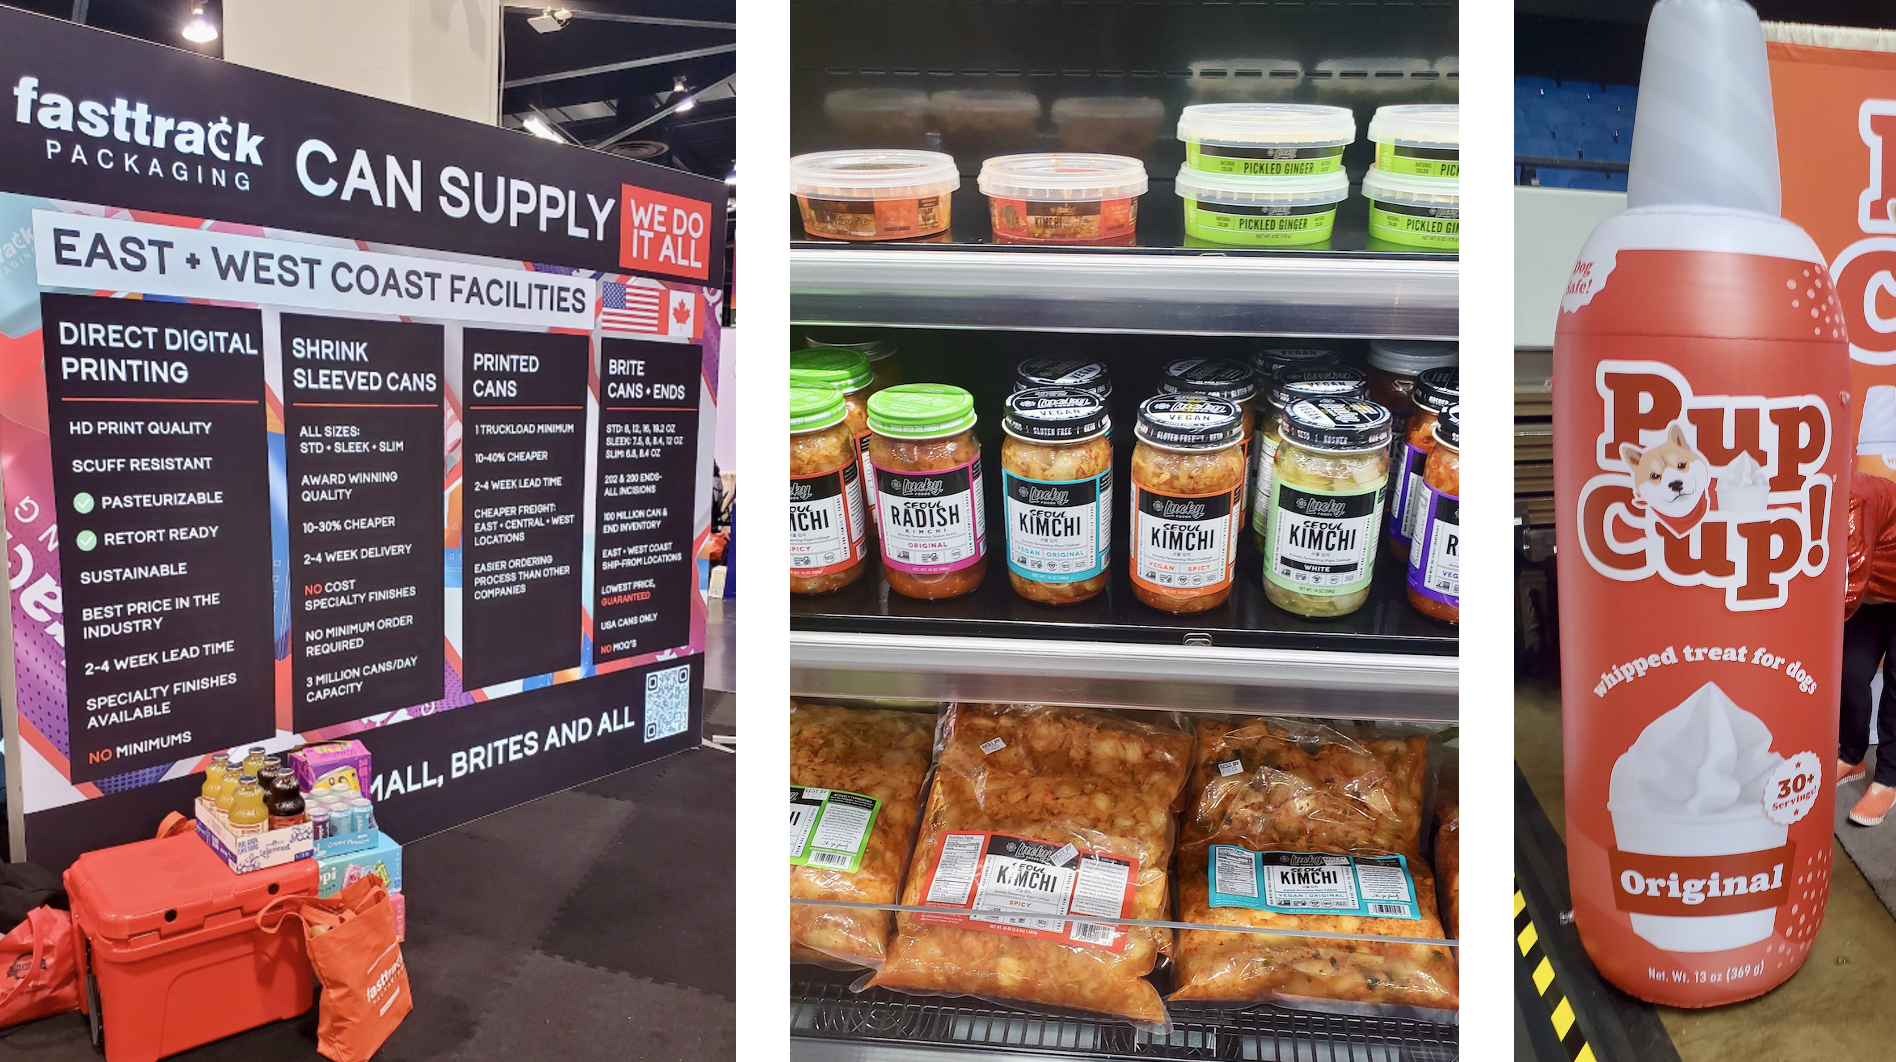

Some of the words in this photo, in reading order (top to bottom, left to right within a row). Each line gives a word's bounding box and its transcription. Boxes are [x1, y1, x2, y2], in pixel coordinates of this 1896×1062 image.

[13, 77, 265, 166] fasttrack
[46, 139, 250, 191] PACKAGING
[1244, 162, 1281, 175] PICKLED
[1284, 163, 1315, 175] GINGER
[296, 139, 421, 212] CAN
[439, 166, 616, 241] SUPPLY
[630, 199, 668, 231] WE
[672, 205, 704, 239] DO
[1239, 218, 1276, 231] PICKLED
[1279, 218, 1308, 230] GINGER
[1406, 218, 1443, 233] PICKLED
[632, 231, 655, 259] IT
[658, 235, 702, 268] ALL
[53, 227, 174, 274] EAST
[211, 246, 322, 290] WEST
[331, 261, 442, 302] COAST
[450, 275, 586, 314] FACILITIES
[1573, 259, 1595, 277] Dog
[59, 321, 158, 350] DIRECT
[164, 328, 258, 355] DIGITAL
[292, 338, 368, 362] SHRINK
[61, 357, 189, 384] PRINTING
[473, 353, 539, 373] PRINTED
[609, 359, 645, 376] BRITE
[292, 369, 382, 391] SLEEVED
[387, 371, 437, 392] CANS
[473, 379, 517, 397] CANS
[608, 382, 643, 398] CANS
[653, 384, 686, 400] ENDS
[69, 421, 93, 434] HD
[97, 421, 145, 434] PRINT
[148, 422, 212, 435] QUALITY
[300, 426, 322, 437] ALL
[324, 426, 360, 438] SIZES:
[481, 424, 536, 435] TRUCKLOAD
[536, 423, 575, 434] MINIMUM
[1600, 366, 1829, 495] Pup
[300, 442, 324, 454] STD
[334, 441, 370, 453] SLEEK
[379, 441, 404, 452] SLIM
[475, 452, 505, 463] 10-40%
[507, 451, 549, 462] CHEAPER
[72, 458, 126, 473] SCUFF
[130, 456, 213, 471] RESISTANT
[301, 474, 346, 486] AWARD
[348, 471, 398, 484] WINNING
[474, 481, 489, 491] 2-4
[490, 479, 518, 490] WEEK
[518, 477, 541, 488] LEAD
[543, 476, 563, 487] TIME
[902, 478, 944, 496] Lucky
[101, 491, 223, 509] PASTEURIZABLE
[301, 488, 353, 502] QUALITY
[604, 487, 618, 496] ALL
[619, 485, 656, 495] INCISIONS
[1029, 486, 1069, 506] Lucky
[474, 506, 517, 519] CHEAPER
[518, 503, 557, 516] FREIGHT:
[904, 501, 942, 509] SEOUL
[1163, 500, 1205, 519] Lucky
[1306, 497, 1347, 517] Lucky
[303, 520, 341, 534] 10-30%
[343, 516, 396, 530] CHEAPER
[474, 521, 498, 533] EAST
[505, 517, 545, 530] CENTRAL
[551, 514, 575, 526] WEST
[891, 504, 960, 528] RADISH
[1020, 512, 1080, 537] KIMCHI
[104, 529, 166, 546] RETORT
[169, 525, 220, 541] READY
[603, 524, 619, 533] END
[620, 520, 662, 532] INVENTORY
[474, 532, 525, 546] LOCATIONS
[1151, 527, 1215, 551] KIMCHI
[1289, 523, 1356, 551] KIMCHI
[1580, 480, 1828, 602] Cup!
[303, 553, 322, 565] 2-4
[324, 549, 359, 563] WEEK
[360, 544, 412, 560] DELIVERY
[602, 547, 622, 558] EAST
[627, 544, 648, 555] WEST
[649, 542, 673, 552] COAST
[644, 553, 682, 565] LOCATIONS
[1017, 546, 1040, 556] VEGAN
[80, 562, 188, 585] SUSTAINABLE
[474, 560, 507, 574] EASIER
[508, 555, 553, 568] ORDERING
[1148, 561, 1175, 571] VEGAN
[1188, 564, 1211, 572] SPICY
[1304, 564, 1331, 573] WHITE
[474, 572, 517, 587] PROCESS
[518, 569, 541, 581] THAN
[543, 565, 570, 578] OTHER
[304, 583, 323, 596] NO
[324, 579, 356, 593] COST
[474, 583, 527, 600] COMPANIES
[601, 582, 632, 595] LOWEST
[82, 604, 123, 622] BEST
[127, 599, 172, 617] PRICE
[175, 596, 190, 609] IN
[193, 593, 221, 607] THE
[305, 592, 366, 611] SPECIALTY
[368, 585, 417, 602] FINISHES
[601, 591, 651, 606] GUARANTEED
[83, 617, 164, 640] INDUSTRY
[305, 629, 323, 642] NO
[325, 621, 375, 639] MINIMUM
[377, 615, 414, 632] ORDER
[601, 620, 617, 631] USA
[618, 616, 638, 627] CANS
[639, 612, 658, 623] ONLY
[306, 637, 364, 657] REQUIRED
[601, 644, 612, 654] NO
[85, 660, 110, 676] 2-4
[114, 653, 159, 670] WEEK
[162, 646, 200, 663] LEAD
[202, 640, 235, 656] TIME
[306, 677, 313, 688] 3
[315, 667, 361, 687] MILLION
[362, 655, 418, 678] CANS/DAY
[1593, 646, 1678, 698] whipped
[1682, 644, 1747, 662] treat
[1751, 646, 1786, 669] for
[1785, 662, 1818, 695] dogs
[86, 684, 170, 711] SPECIALTY
[173, 672, 238, 695] FINISHES
[306, 681, 364, 703] CAPACITY
[87, 702, 171, 730] AVAILABLE
[88, 749, 112, 765] NO
[116, 731, 192, 759] MINIMUMS
[451, 731, 539, 779] BRITES
[544, 718, 593, 751] AND
[597, 706, 636, 736] ALL
[1776, 772, 1815, 799] 30+
[1772, 786, 1818, 812] Servings!
[1281, 870, 1338, 885] KIMCHI
[1620, 863, 1785, 905] Original
[1009, 900, 1031, 908] SPICY
[1694, 971, 1707, 983] 13
[1710, 973, 1723, 983] oz
[1726, 965, 1750, 983] (369
[1752, 959, 1765, 979] g)
